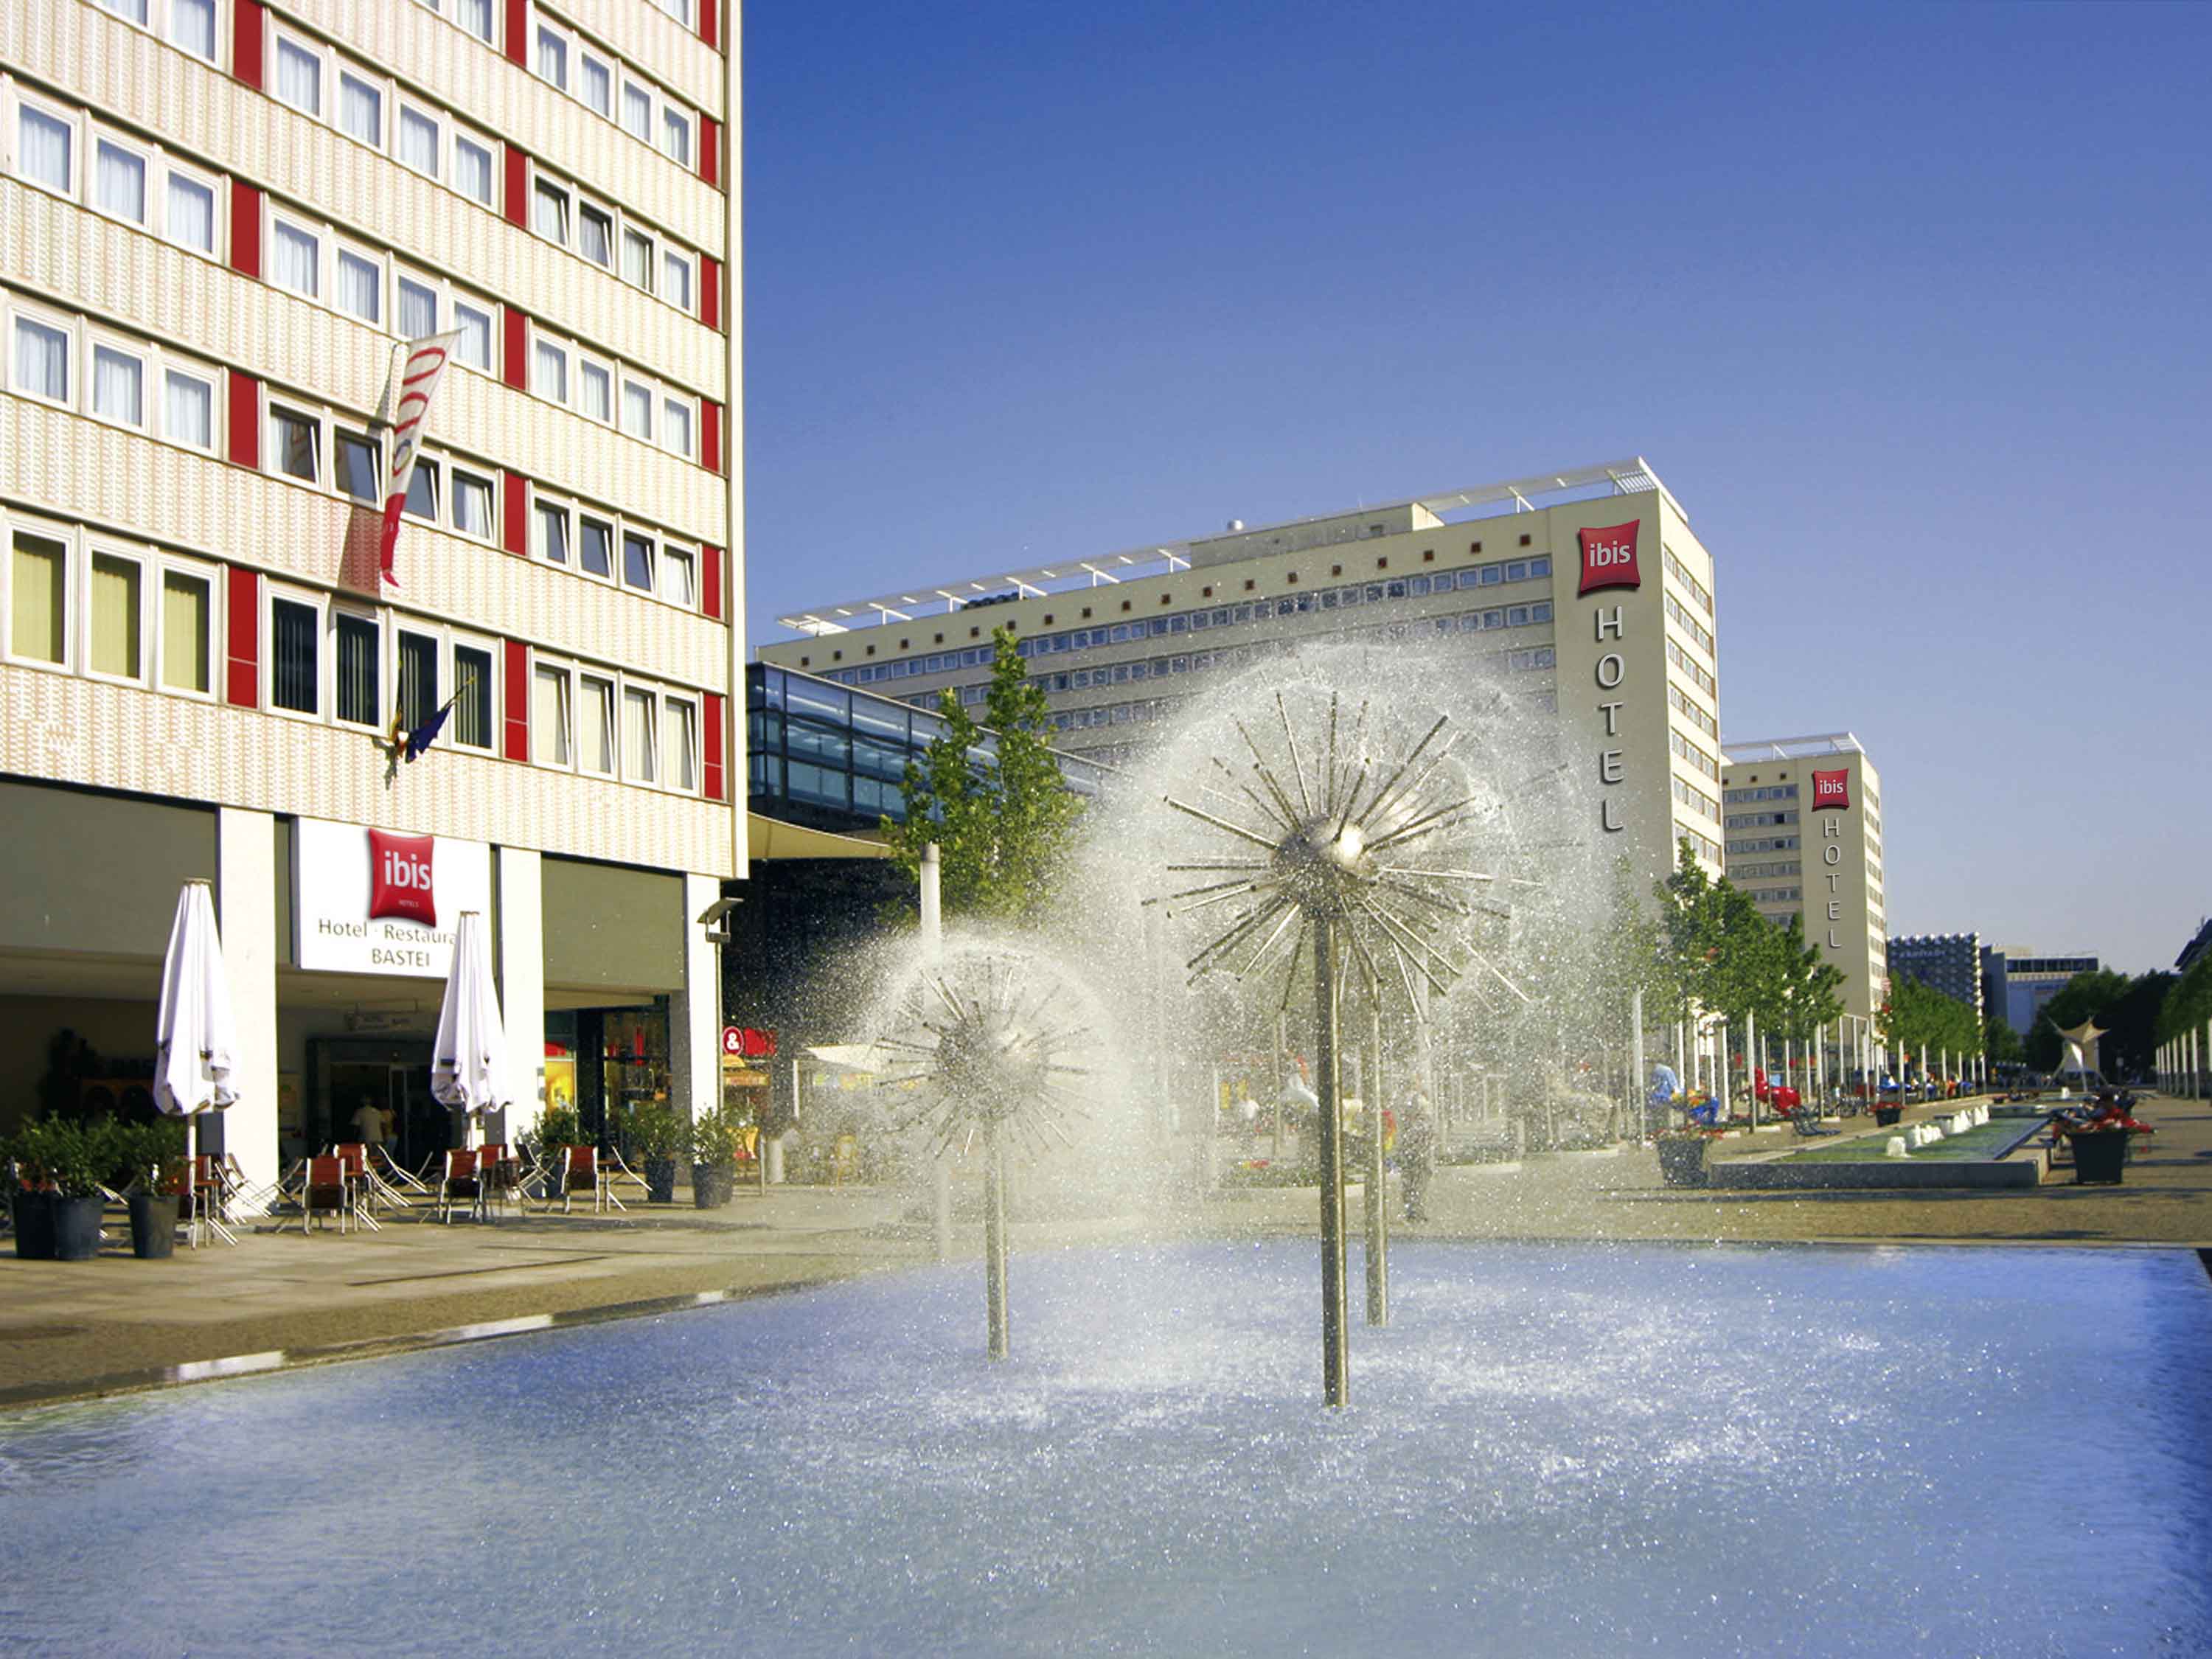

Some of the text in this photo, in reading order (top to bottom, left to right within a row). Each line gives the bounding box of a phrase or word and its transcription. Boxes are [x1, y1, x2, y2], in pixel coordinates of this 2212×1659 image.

[1590, 540, 1631, 567] ibis
[1597, 605, 1625, 830] HOTEL
[1819, 779, 1844, 795] ibis
[383, 850, 432, 891] ibis
[1824, 817, 1842, 948] HOTEL
[318, 918, 456, 945] Hotel Restaura
[371, 948, 430, 967] BASTEI
